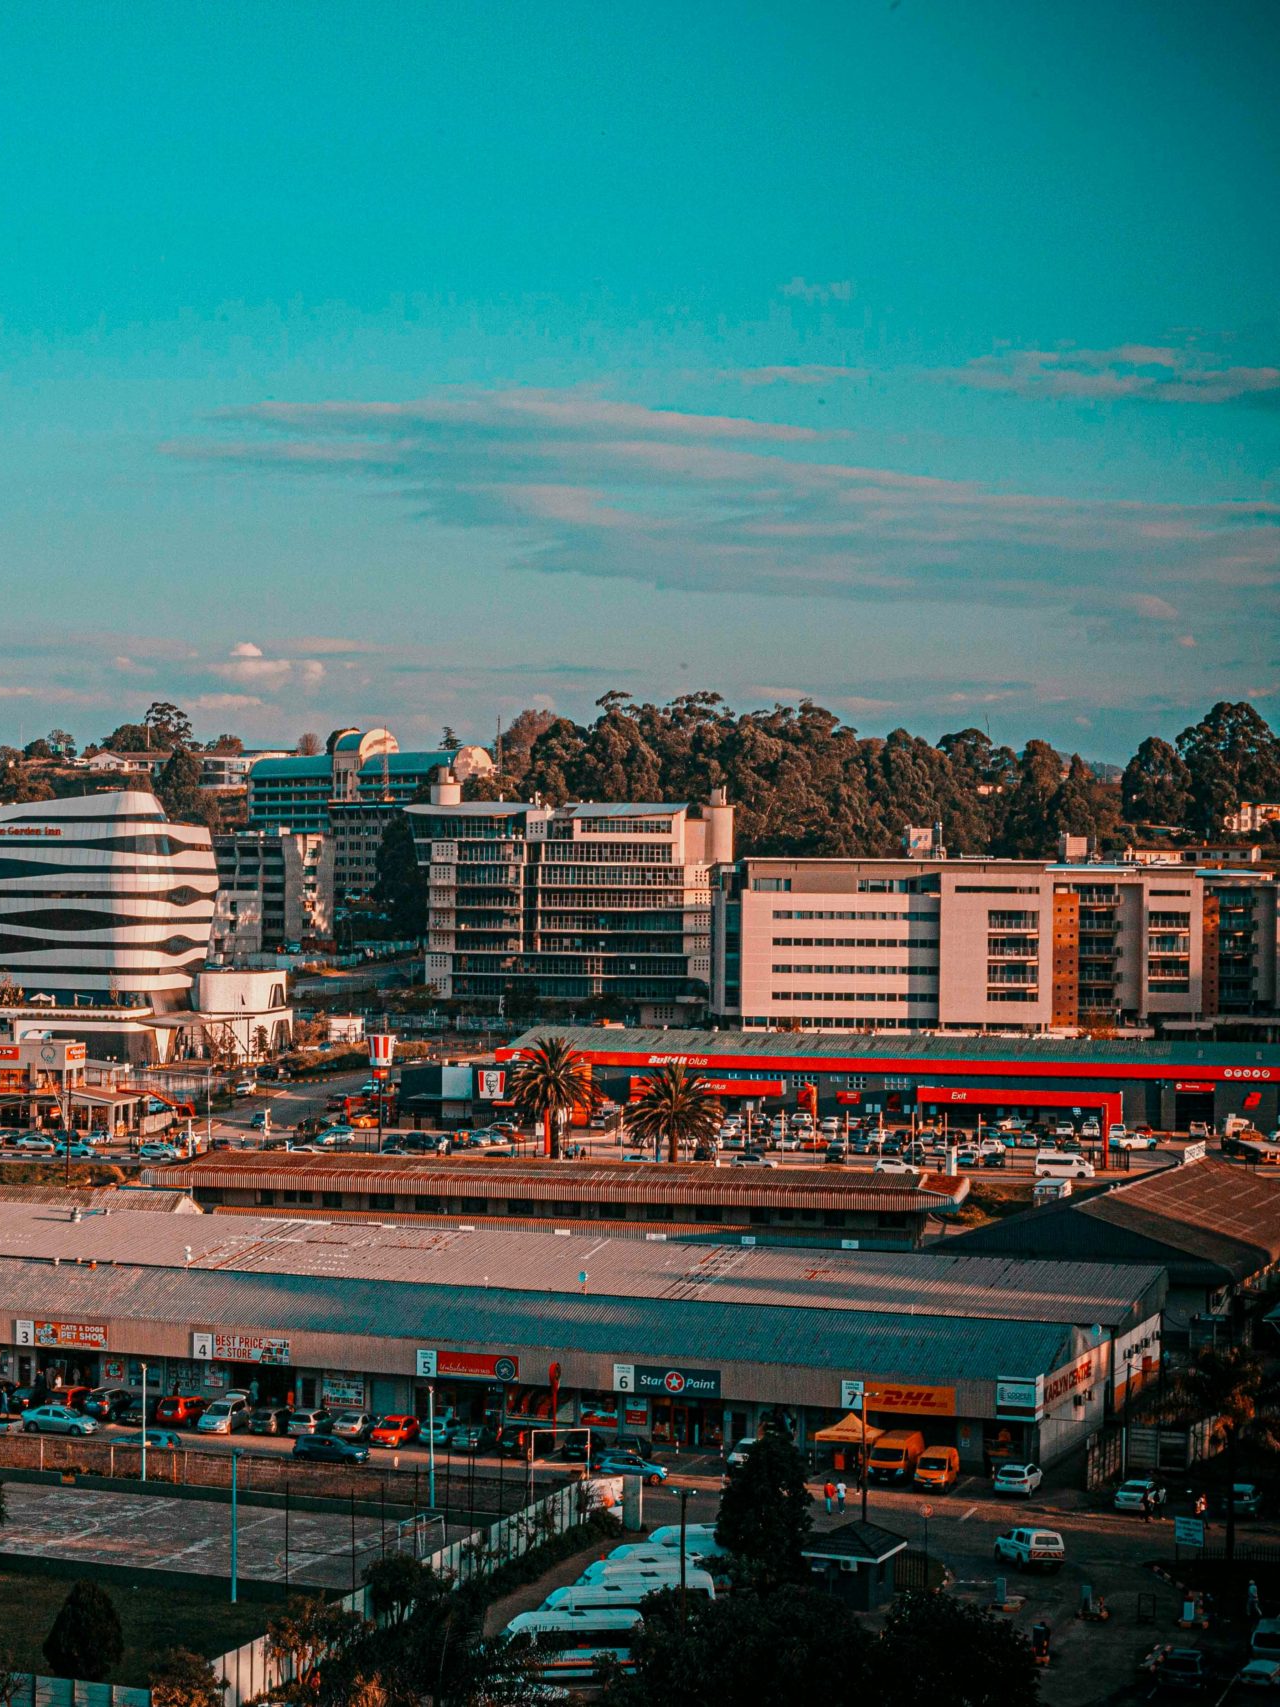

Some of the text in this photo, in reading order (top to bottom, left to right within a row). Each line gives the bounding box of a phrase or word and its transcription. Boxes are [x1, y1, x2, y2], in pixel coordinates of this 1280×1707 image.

[7, 826, 42, 836] Garden
[44, 827, 62, 836] Inn
[951, 1091, 967, 1100] Exit
[85, 1325, 104, 1333] DOGS
[21, 1331, 29, 1344] 3
[61, 1331, 104, 1342] PET SHOP
[215, 1335, 237, 1347] BEST
[239, 1337, 264, 1349] PRICE
[198, 1344, 207, 1357] 4
[227, 1347, 252, 1359] STORE
[422, 1362, 431, 1375] 5
[619, 1375, 628, 1389] 6
[640, 1375, 716, 1390] Star Paint
[1044, 1360, 1092, 1405] KARLYN CENTRE
[848, 1392, 857, 1406] 7
[883, 1390, 937, 1408] DHL
